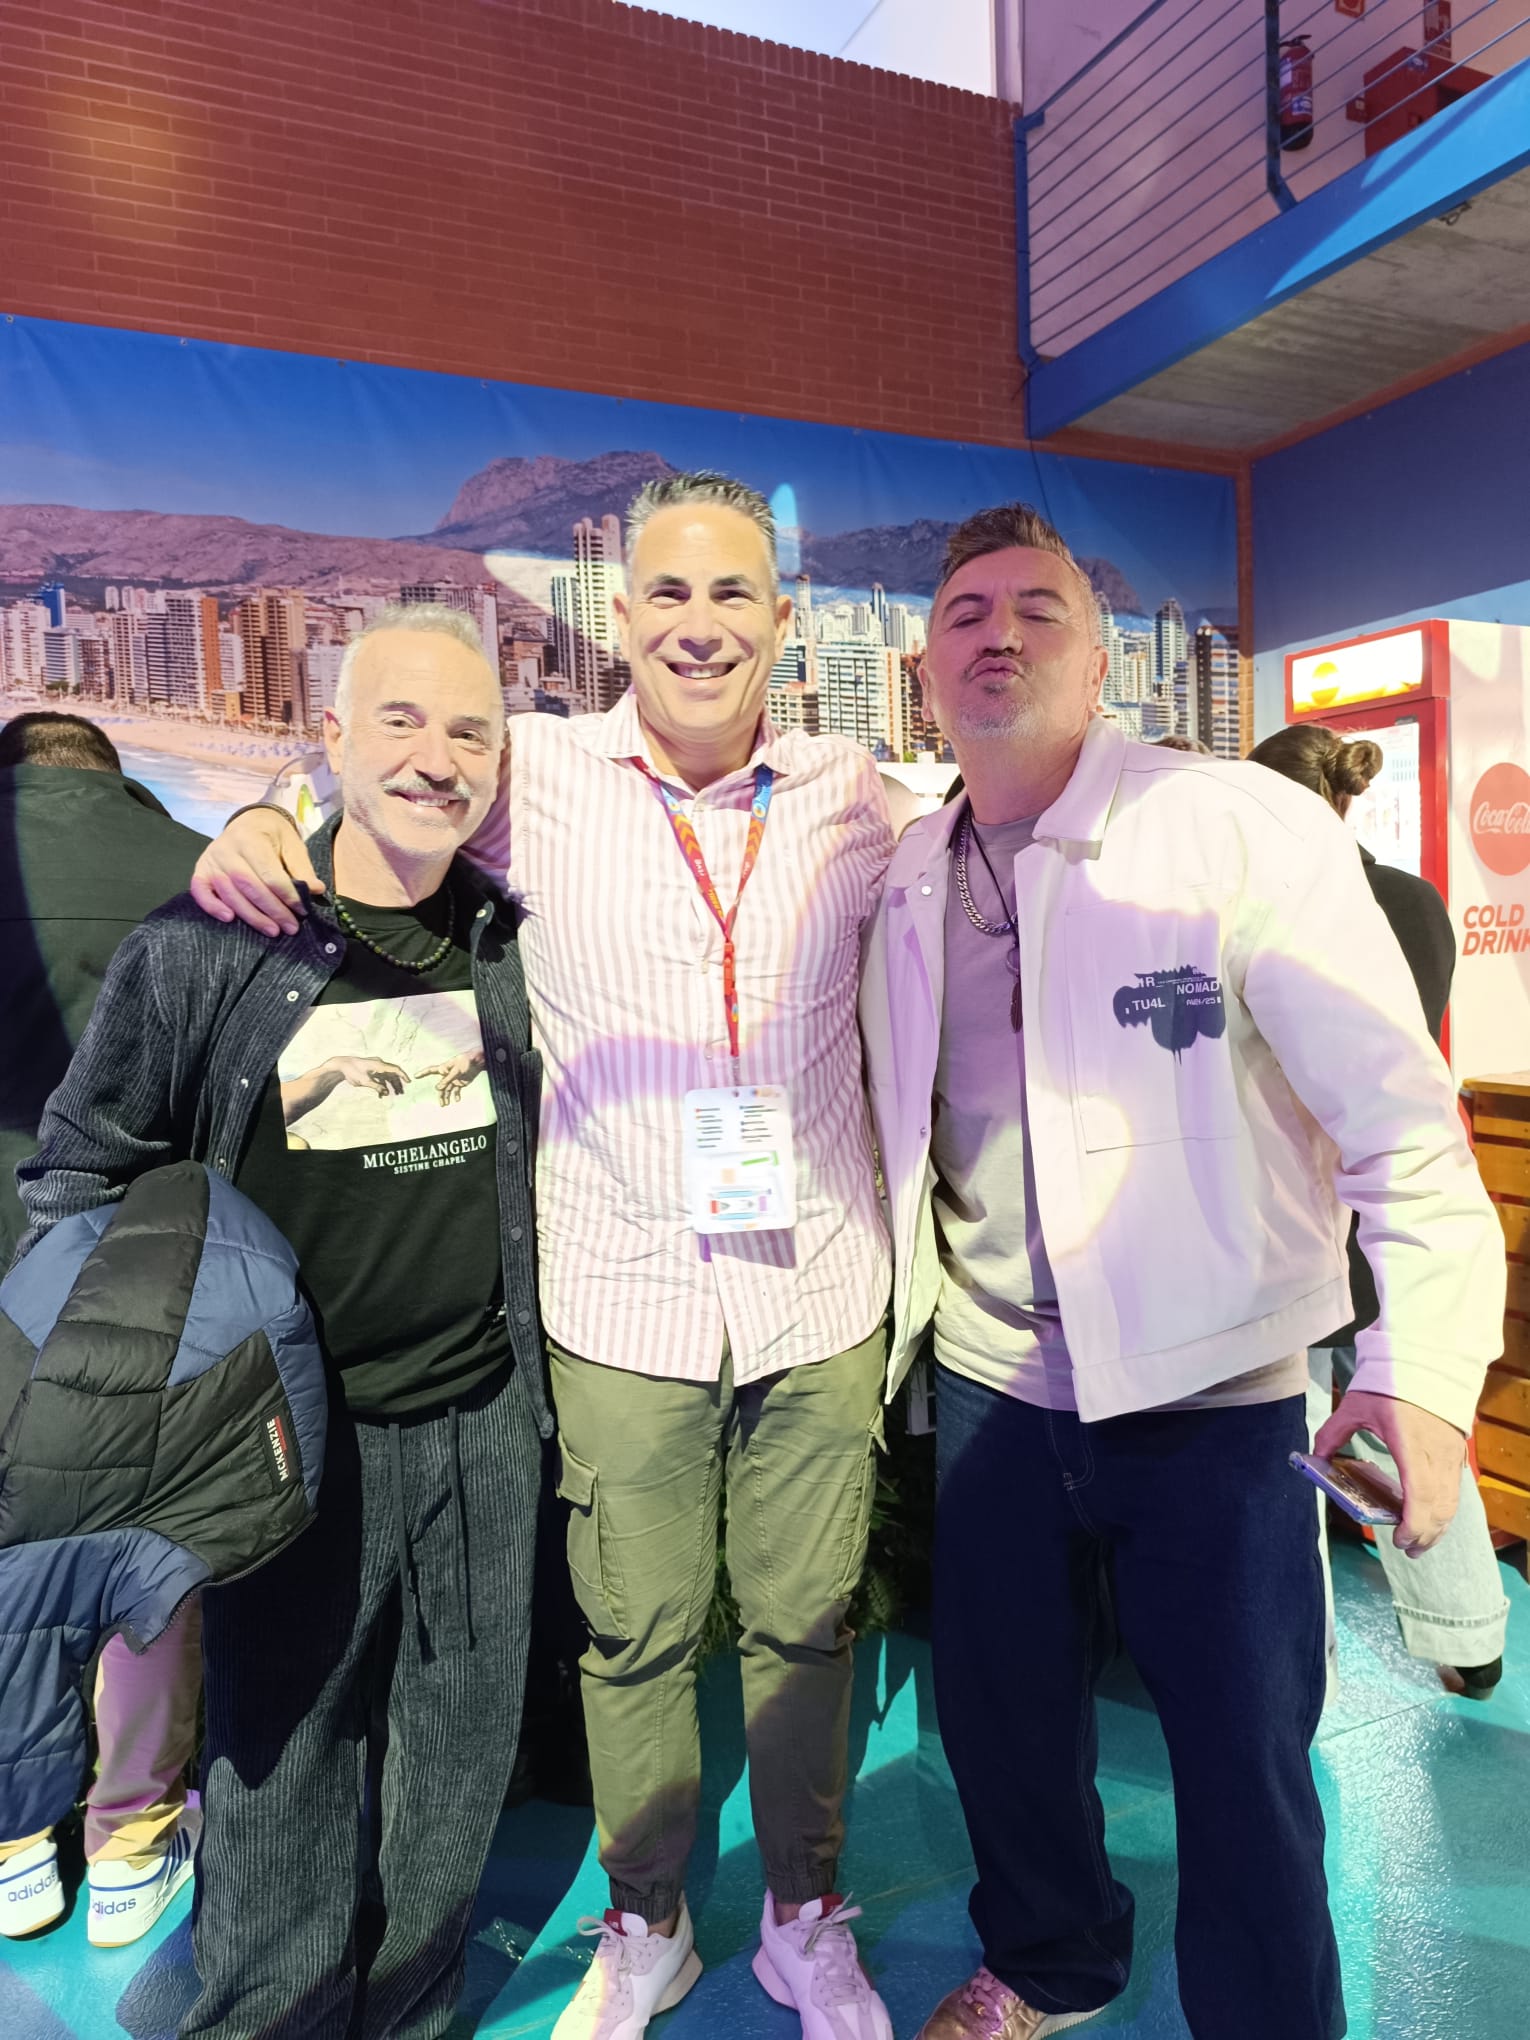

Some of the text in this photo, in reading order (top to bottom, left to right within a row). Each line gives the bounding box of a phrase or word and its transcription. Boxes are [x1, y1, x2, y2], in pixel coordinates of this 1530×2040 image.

[1463, 904, 1525, 929] COLD
[363, 1134, 487, 1169] MICHELANGELO
[394, 1155, 467, 1175] SISTINE CHAPEL
[266, 1418, 289, 1482] MCKENZIE
